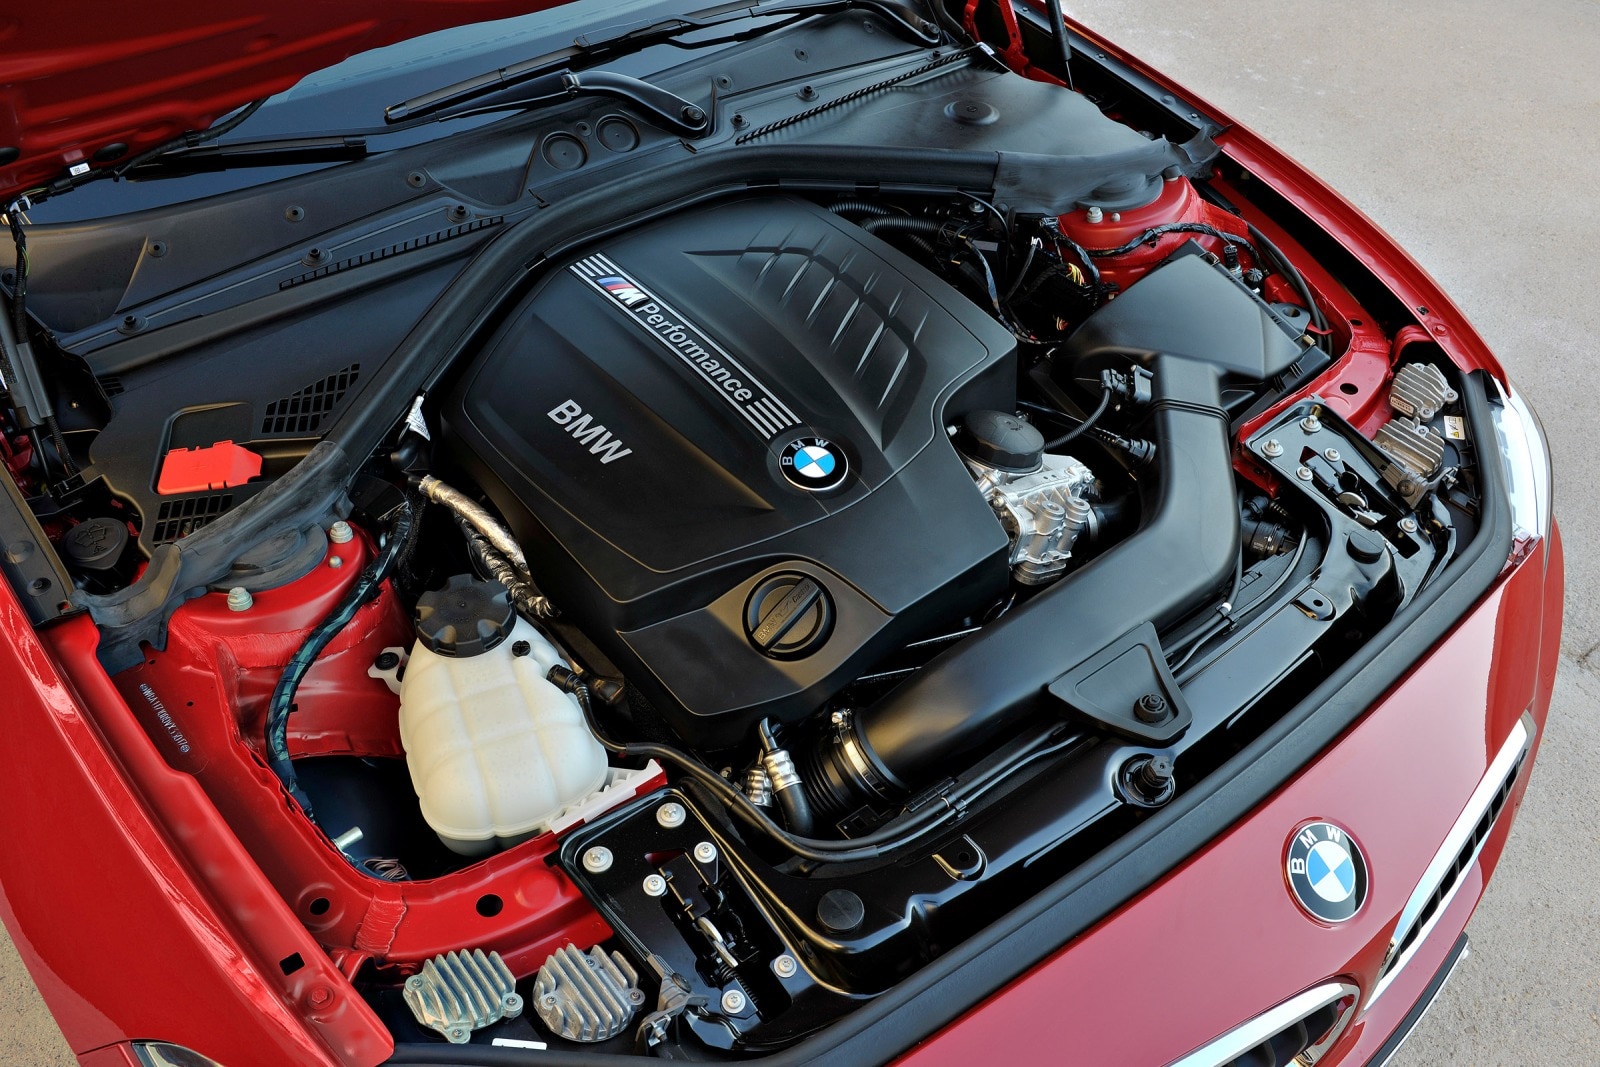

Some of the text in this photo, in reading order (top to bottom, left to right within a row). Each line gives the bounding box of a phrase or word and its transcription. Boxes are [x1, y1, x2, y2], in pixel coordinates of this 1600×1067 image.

[635, 302, 753, 401] Performance
[547, 399, 633, 465] BMW
[782, 438, 829, 466] BMW
[1291, 825, 1341, 875] BMW
